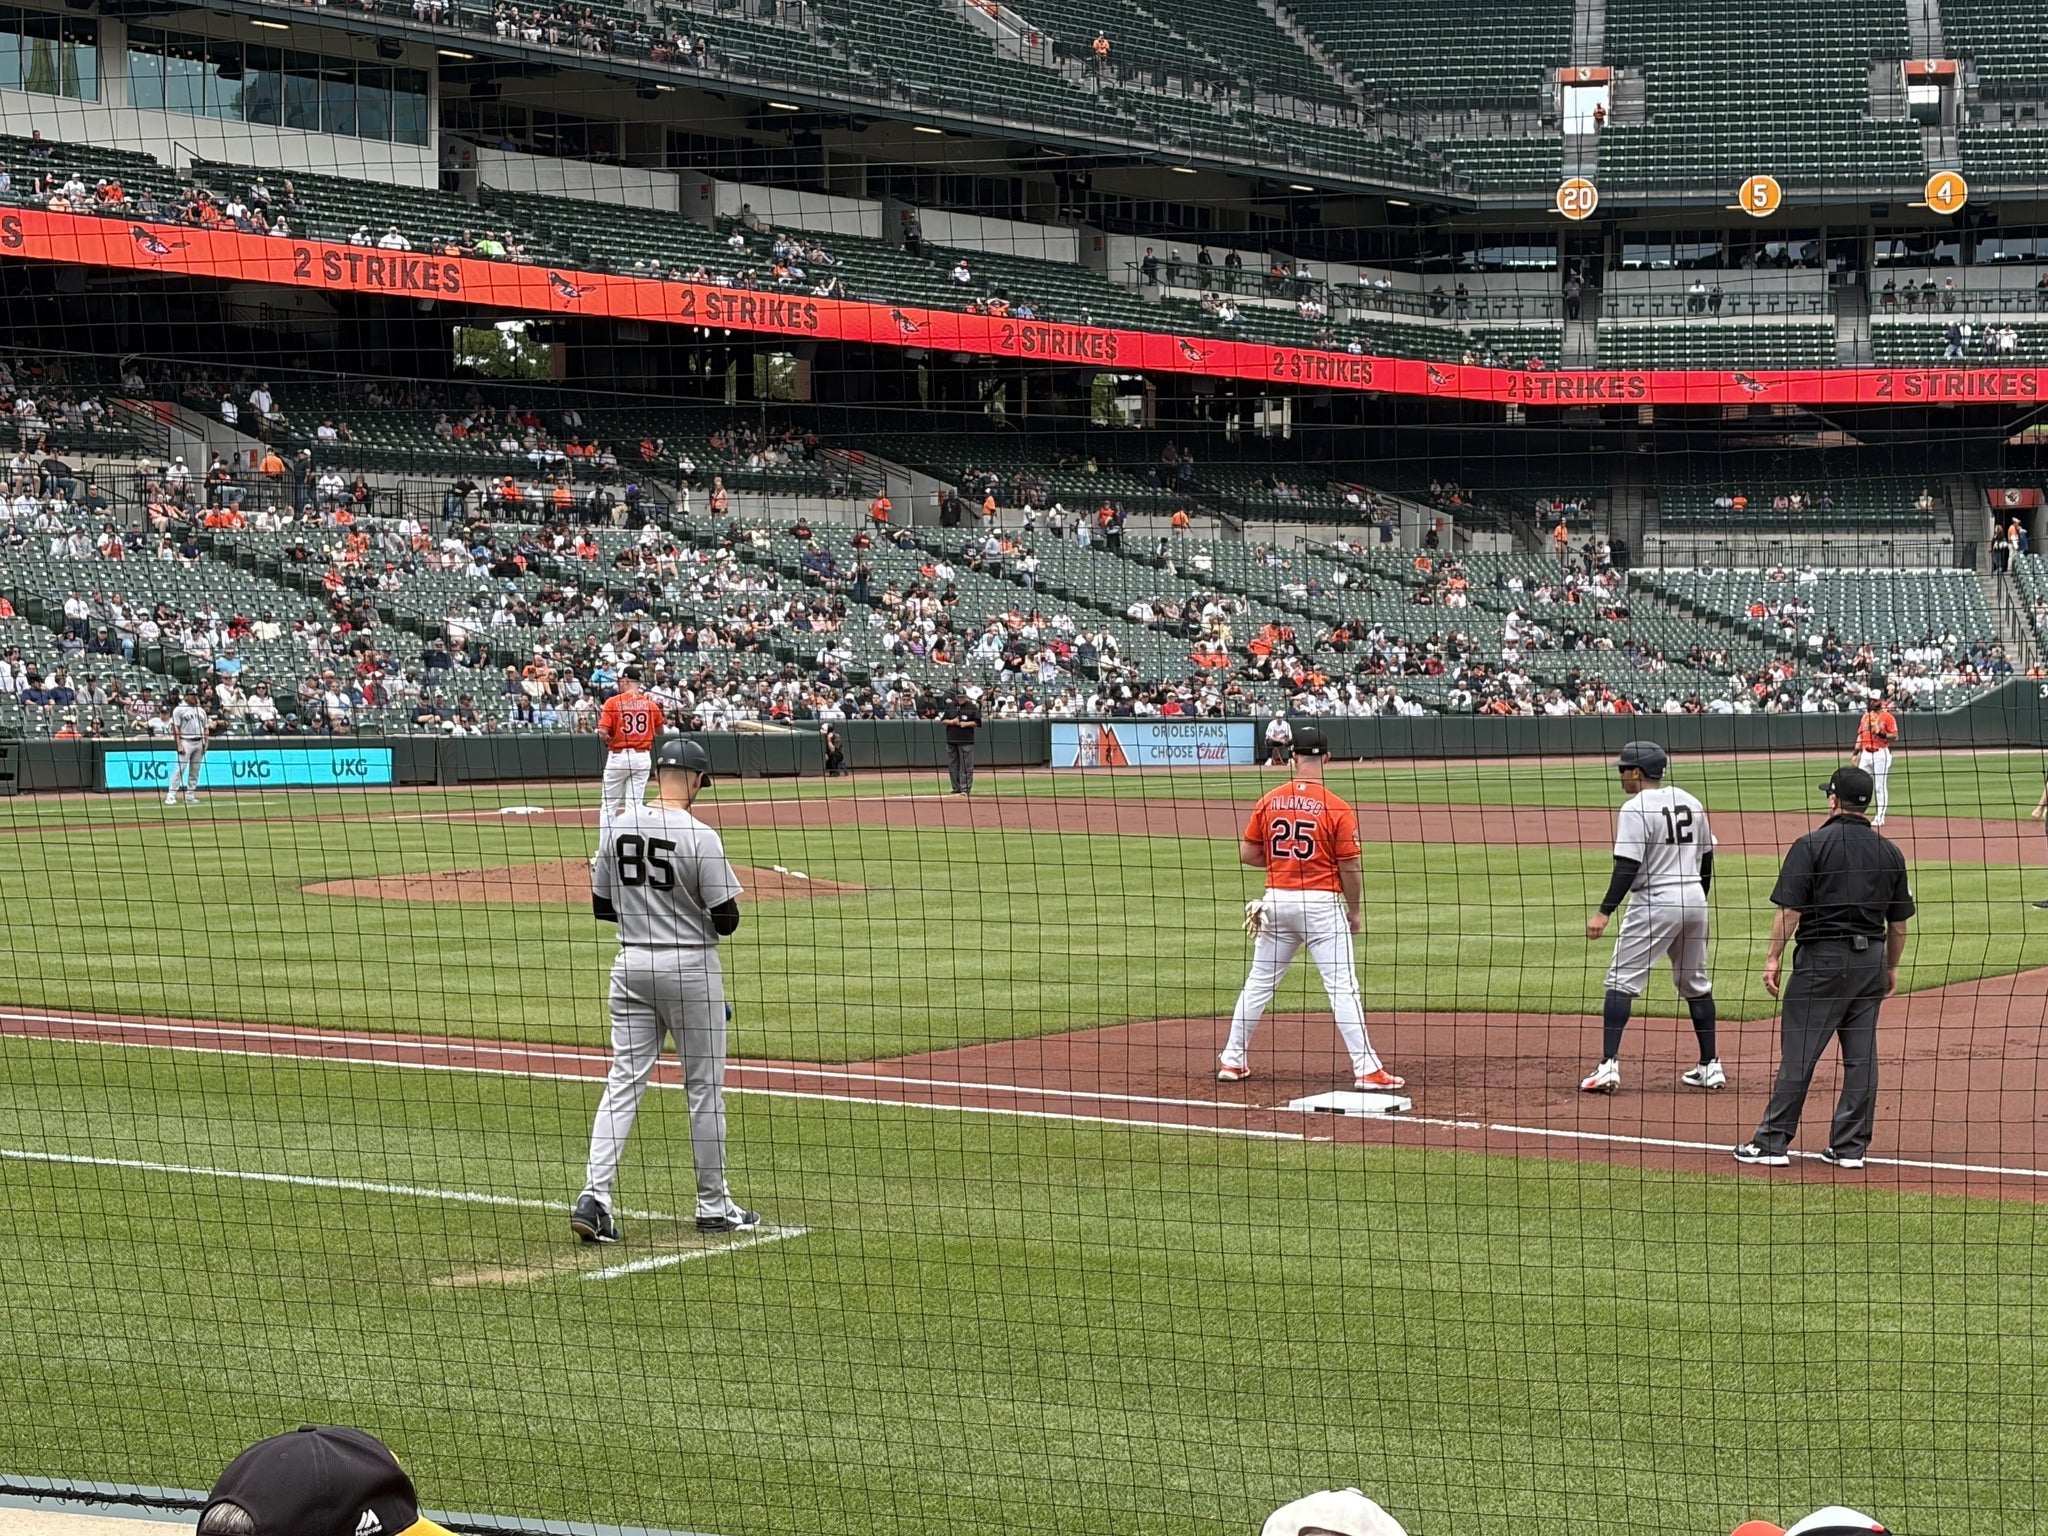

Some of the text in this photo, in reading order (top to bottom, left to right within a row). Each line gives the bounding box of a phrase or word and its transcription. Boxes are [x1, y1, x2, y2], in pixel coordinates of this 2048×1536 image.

[1564, 187, 1592, 210] 20
[1753, 184, 1768, 208] 5
[1937, 180, 1951, 205] 4
[293, 247, 461, 294] 2 STRIKES
[681, 289, 819, 330] 2 STRIKES
[1001, 324, 1118, 360] 2 STRIKES
[1273, 352, 1373, 385] 2 STRIKES
[1507, 375, 1646, 399] 2 STRIKES
[1876, 374, 2037, 397] 2 STRIKES
[620, 711, 649, 736] 38
[1152, 725, 1196, 738] ORIOLES
[1150, 743, 1228, 760] CHOOSE Chill
[129, 760, 169, 780] UKG
[233, 759, 271, 778] UKG
[332, 758, 368, 777] UKG
[1270, 796, 1324, 816] ALONSO
[1661, 804, 1694, 845] 12
[1270, 817, 1317, 861] 25
[616, 833, 677, 892] 85
